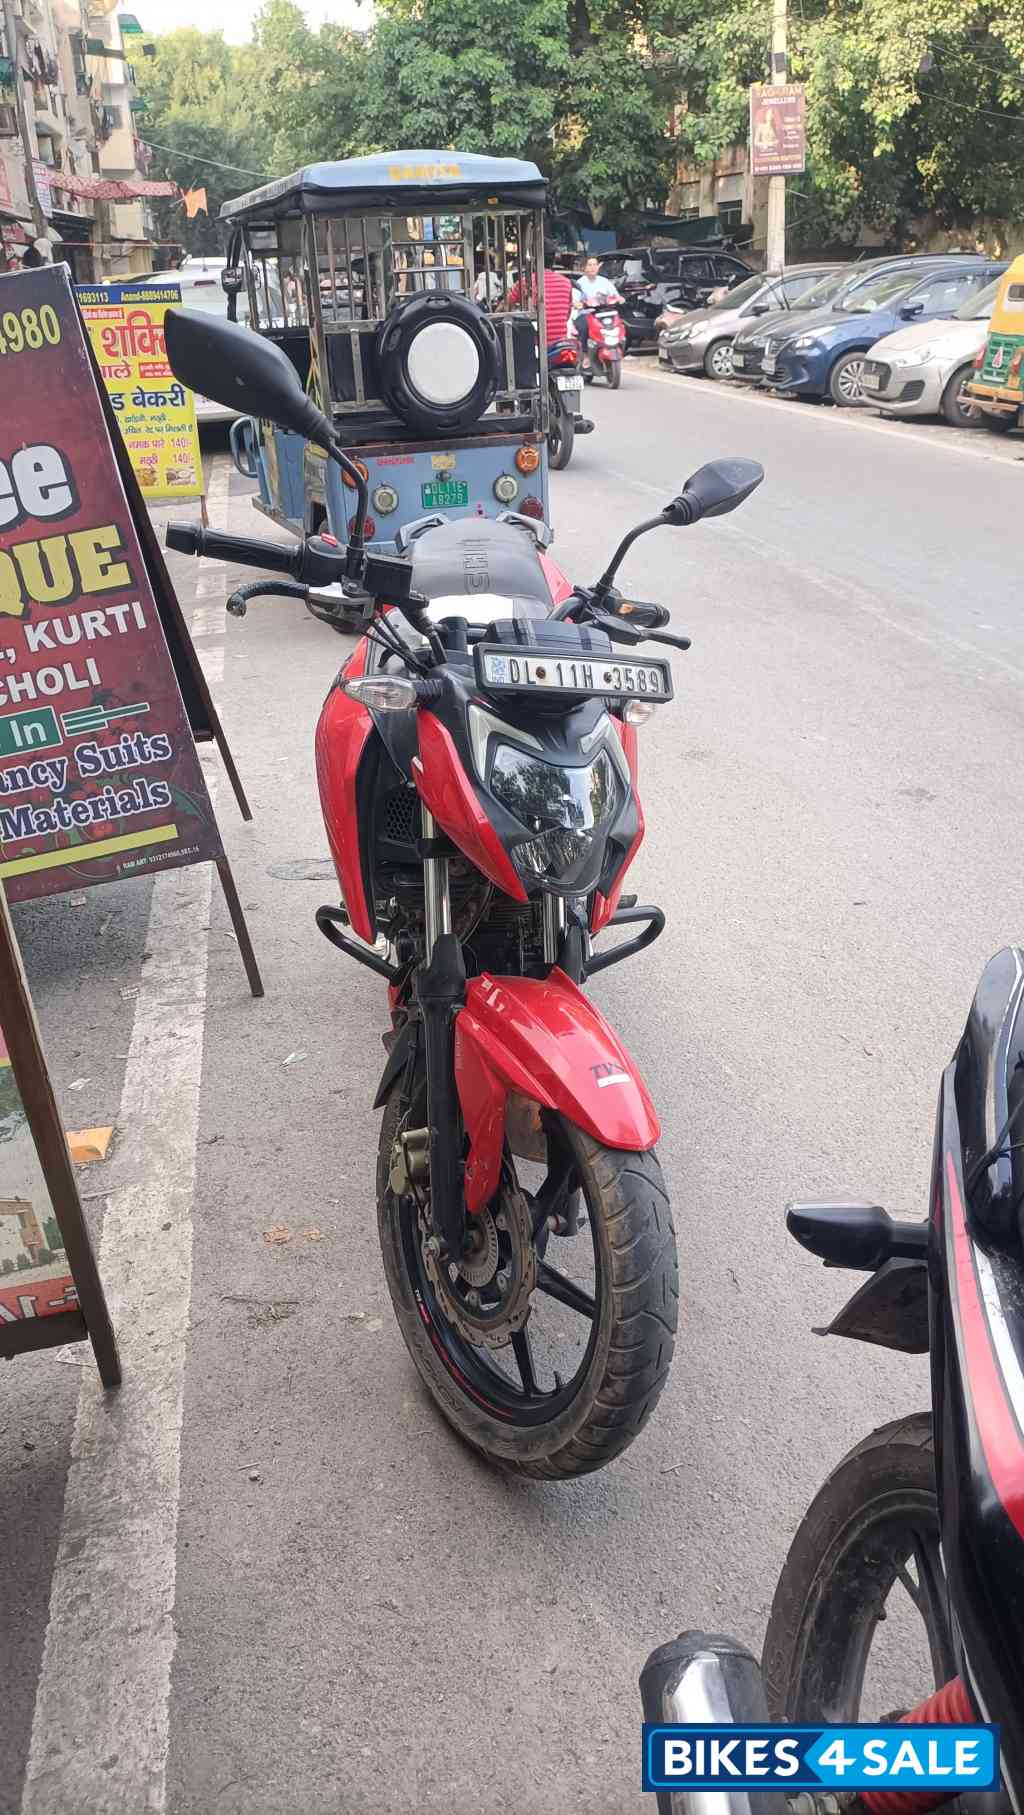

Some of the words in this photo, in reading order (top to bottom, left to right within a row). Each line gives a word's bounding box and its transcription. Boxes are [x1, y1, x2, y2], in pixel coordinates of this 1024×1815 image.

[131, 383, 185, 408] बेकरी
[23, 602, 148, 653] KURTI
[509, 658, 537, 685] DL
[555, 662, 594, 689] 11H
[612, 667, 660, 693] 3589
[10, 719, 47, 748] In
[75, 731, 172, 777] Suits
[0, 780, 171, 842] Materials
[589, 1061, 626, 1079] TVS
